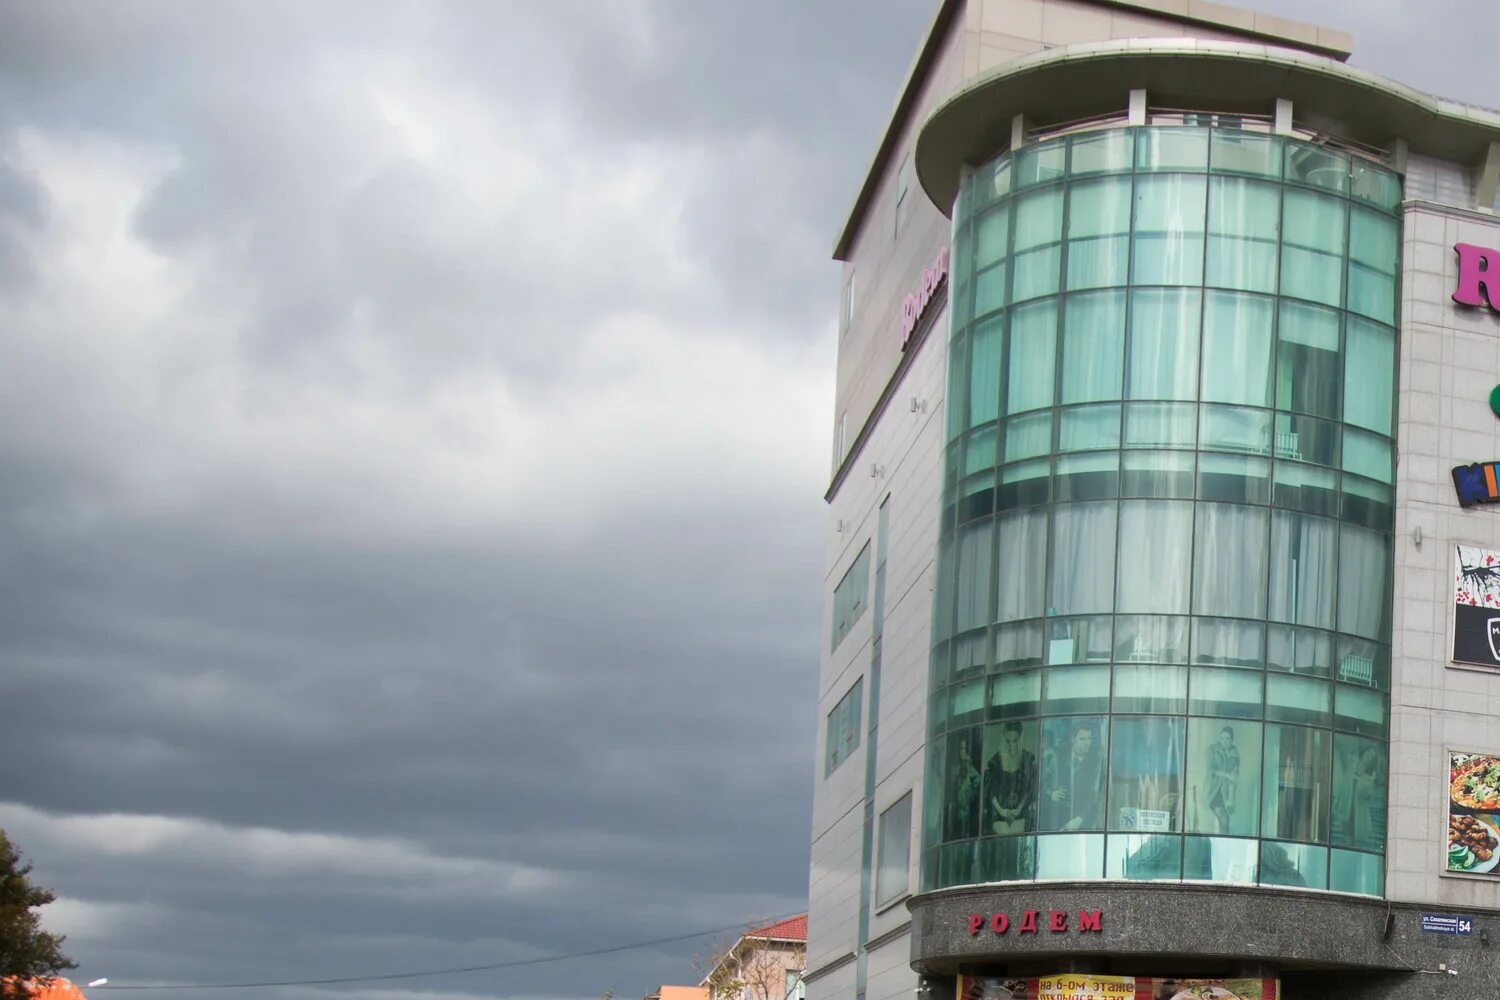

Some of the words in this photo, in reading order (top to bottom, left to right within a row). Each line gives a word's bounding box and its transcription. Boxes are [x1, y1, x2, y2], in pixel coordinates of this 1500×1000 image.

[969, 910, 1103, 936] РОДЕМ
[1459, 920, 1471, 932] 54
[1040, 981, 1052, 990] на
[1056, 979, 1086, 991] 6-ом
[1092, 981, 1134, 993] этаже
